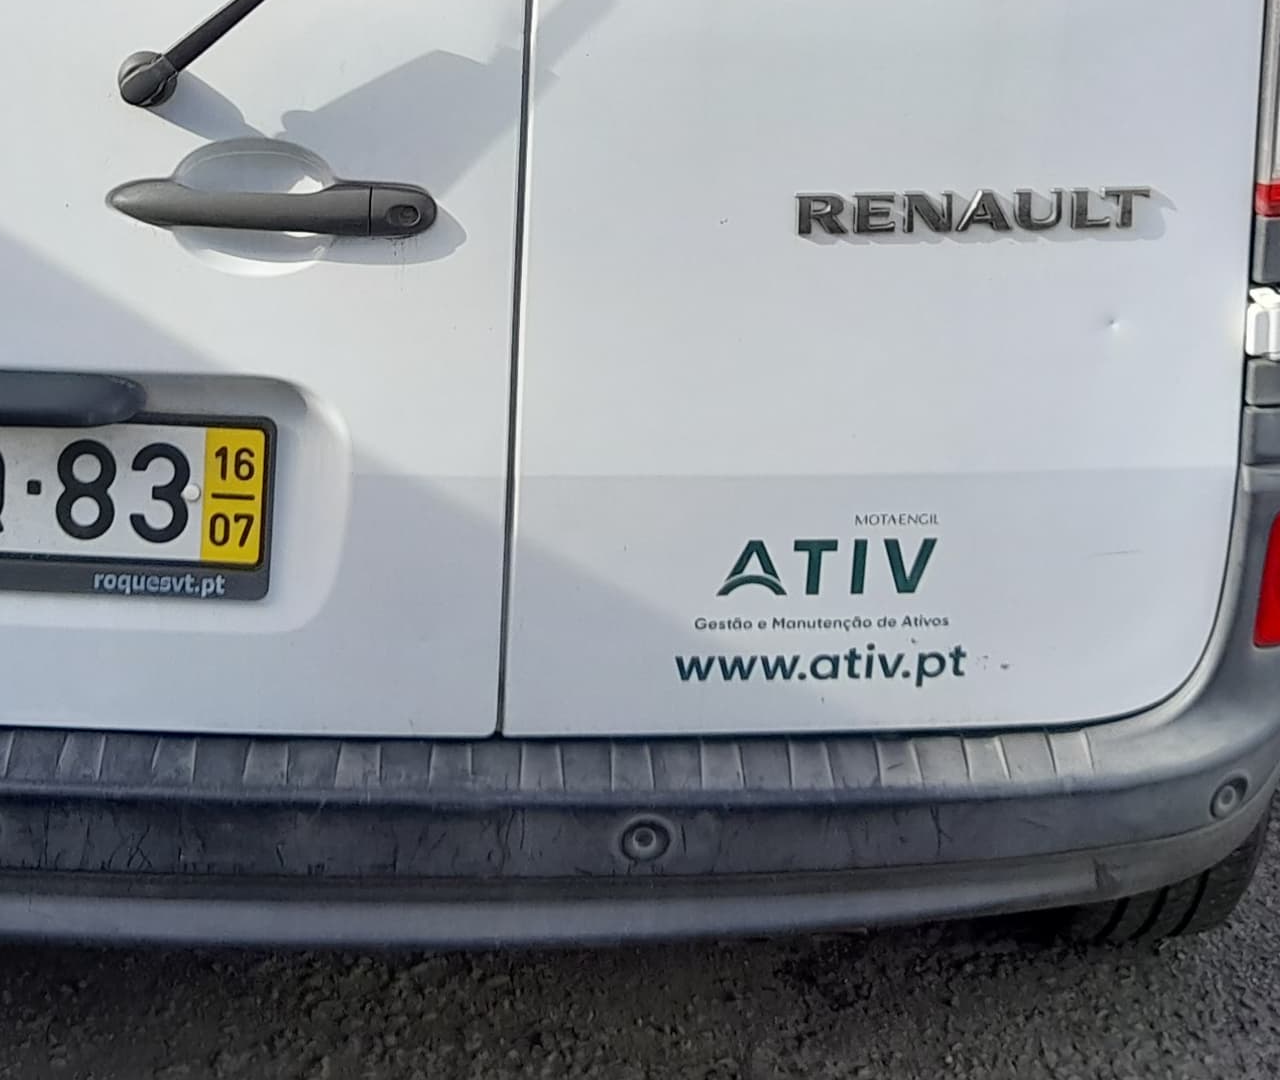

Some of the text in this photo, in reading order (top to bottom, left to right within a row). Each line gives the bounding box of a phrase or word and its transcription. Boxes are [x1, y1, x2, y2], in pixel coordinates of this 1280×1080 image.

[795, 185, 1152, 236] RENAULT
[214, 446, 256, 481] 16
[208, 512, 255, 548] 07
[716, 537, 938, 597] ATIV
[93, 573, 226, 598] roquesvt.pt
[694, 614, 950, 633] Gestão e Manutenção de Ativos
[674, 643, 968, 688] www.ativ.pt
